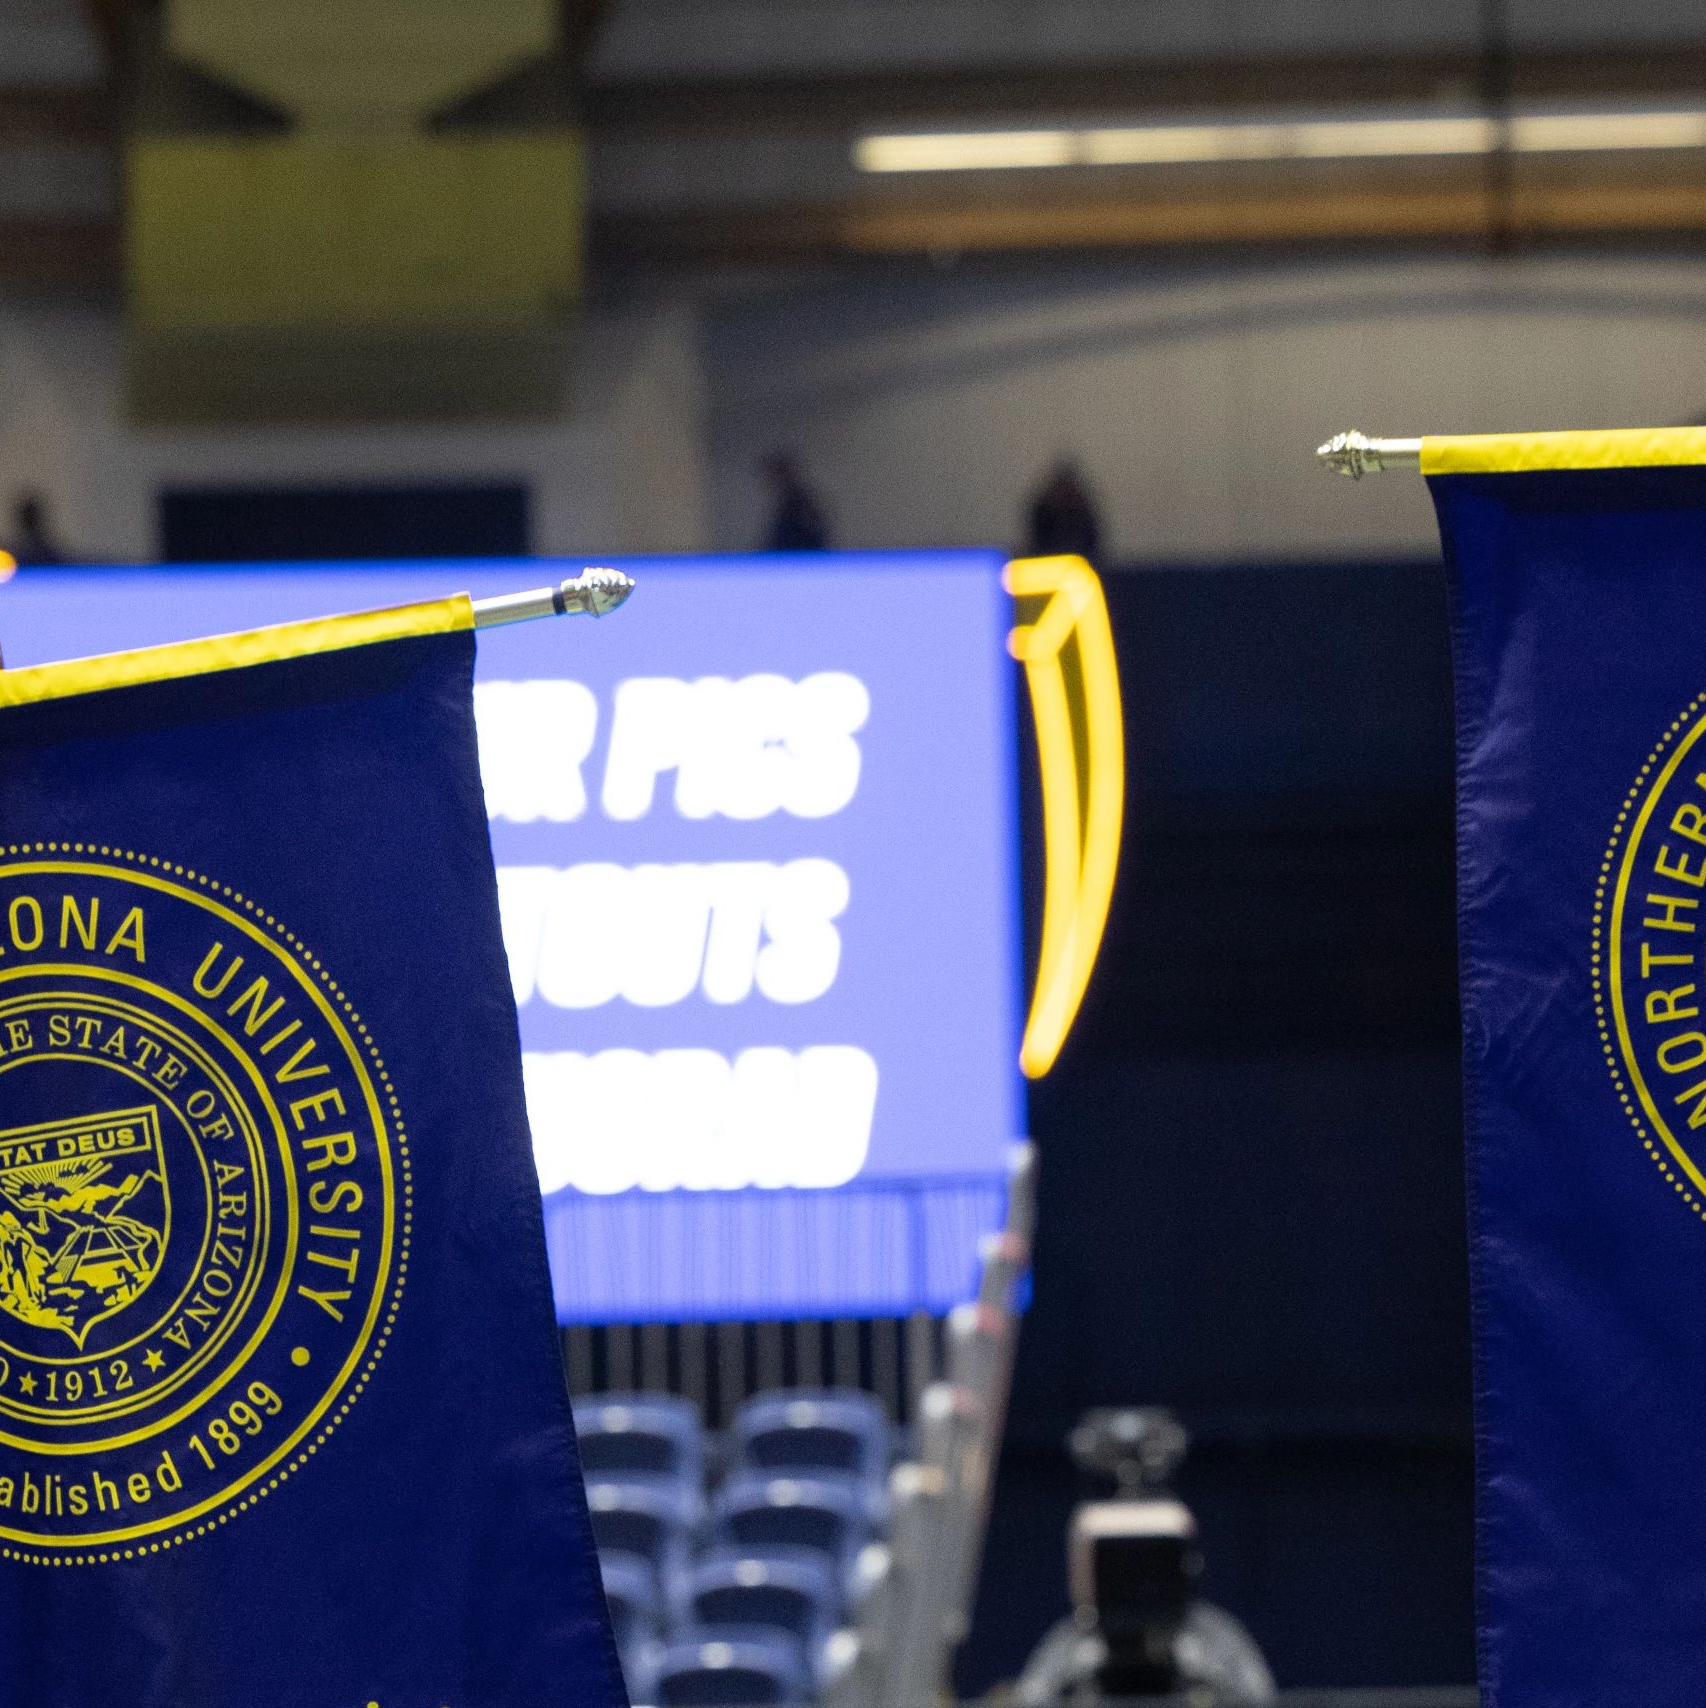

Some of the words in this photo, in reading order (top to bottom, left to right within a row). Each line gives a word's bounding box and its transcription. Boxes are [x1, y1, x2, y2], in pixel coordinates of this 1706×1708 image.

[48, 1015, 187, 1091] STATE
[56, 1127, 135, 1157] DEUS
[186, 1089, 233, 1143] OF
[192, 943, 362, 1323] UNIVERSITY
[165, 1160, 247, 1352] ARIZONA
[45, 1359, 133, 1402] 1912
[189, 1379, 283, 1470] 1899
